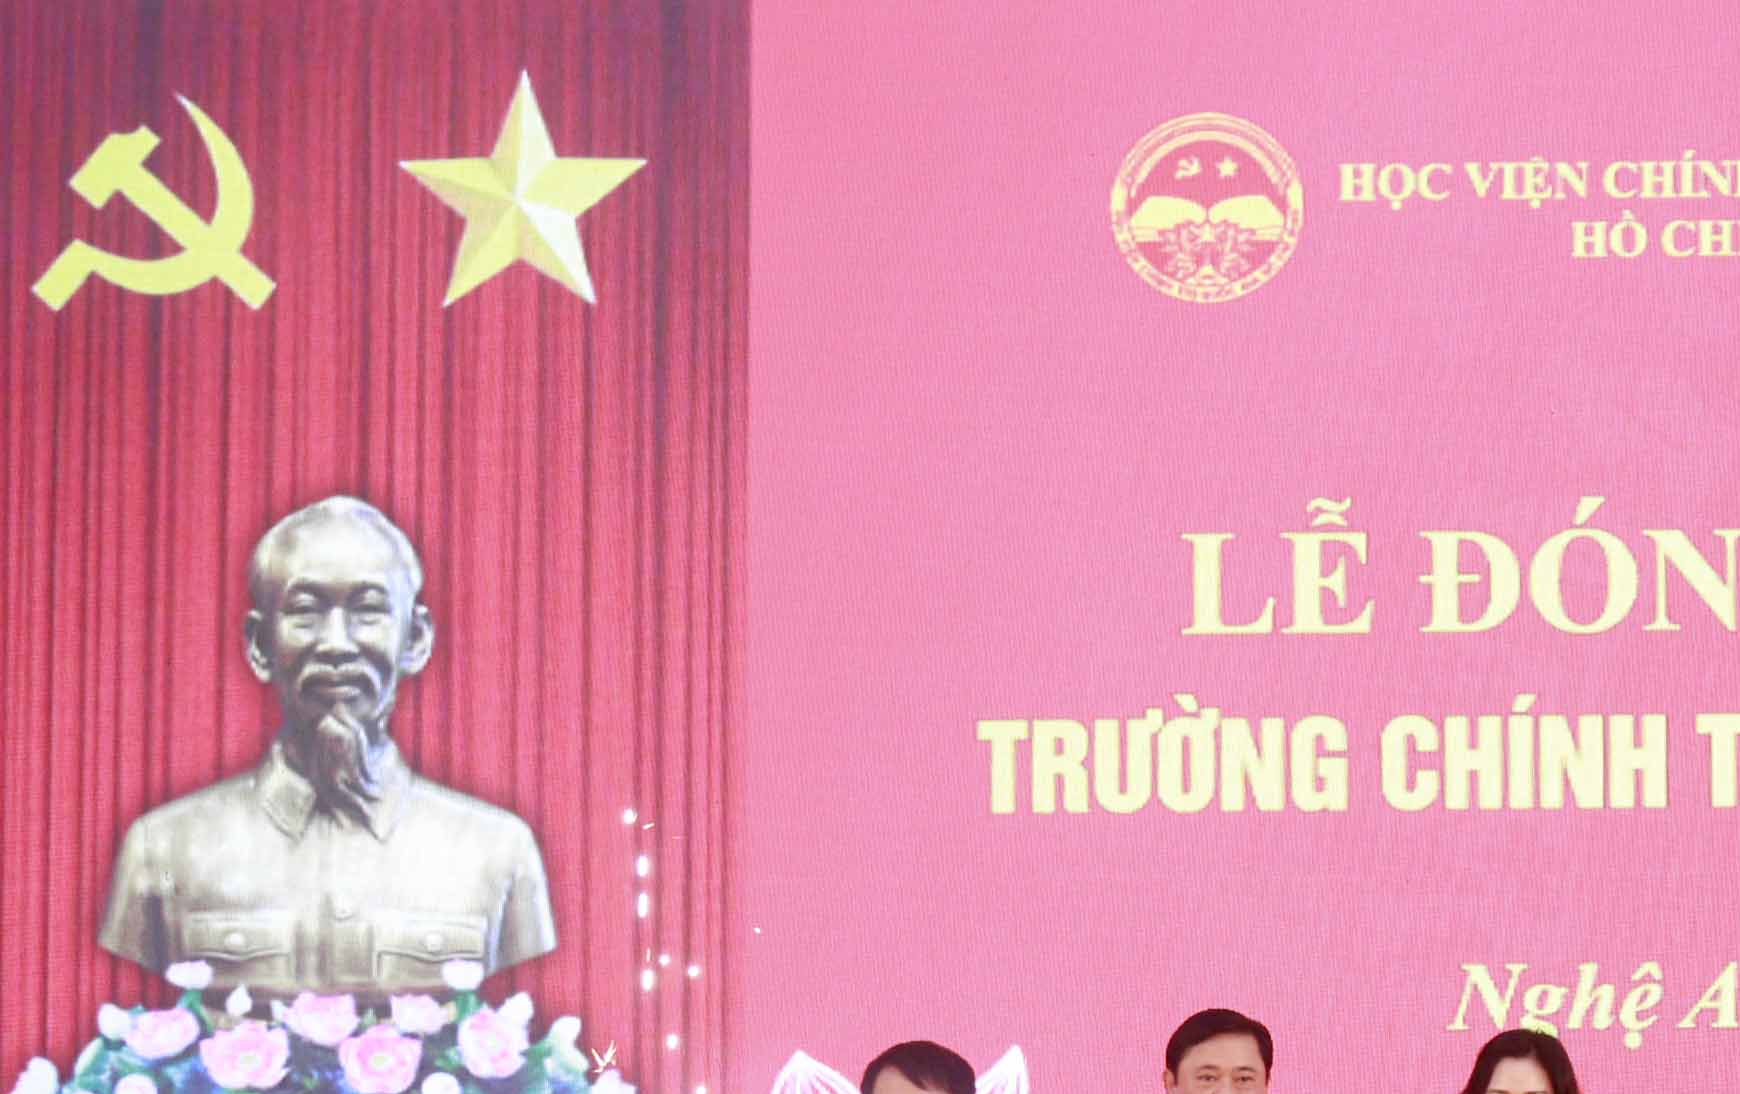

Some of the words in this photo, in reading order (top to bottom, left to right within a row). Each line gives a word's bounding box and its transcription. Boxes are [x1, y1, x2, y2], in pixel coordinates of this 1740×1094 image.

[1339, 162, 1452, 212] HỌC
[1465, 155, 1588, 209] VIỆN
[1571, 211, 1649, 260] HỒ
[1180, 496, 1377, 636] LỄ
[977, 692, 1350, 815] TRƯỜNG
[1380, 692, 1669, 813] CHÍNH
[1445, 959, 1665, 1050] Nghệ
